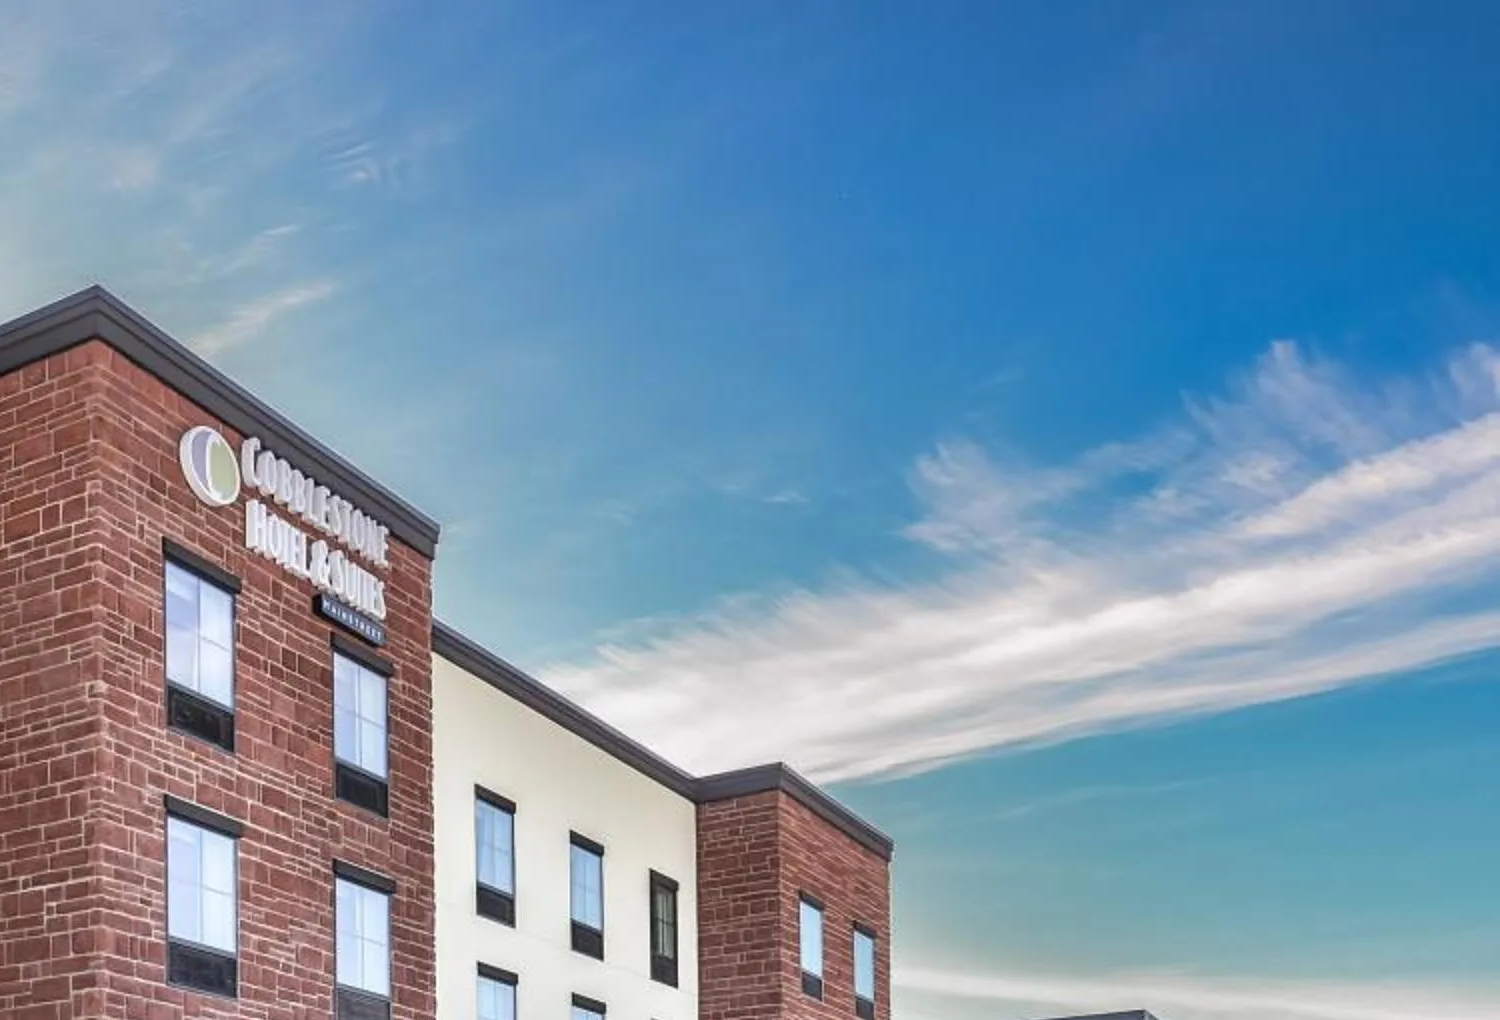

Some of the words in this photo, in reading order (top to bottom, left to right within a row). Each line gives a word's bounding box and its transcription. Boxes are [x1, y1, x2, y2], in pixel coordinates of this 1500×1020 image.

[241, 437, 389, 569] COBBLESTONE
[245, 499, 309, 578] HOTEL
[309, 540, 329, 592] &
[328, 550, 386, 620] SUITES
